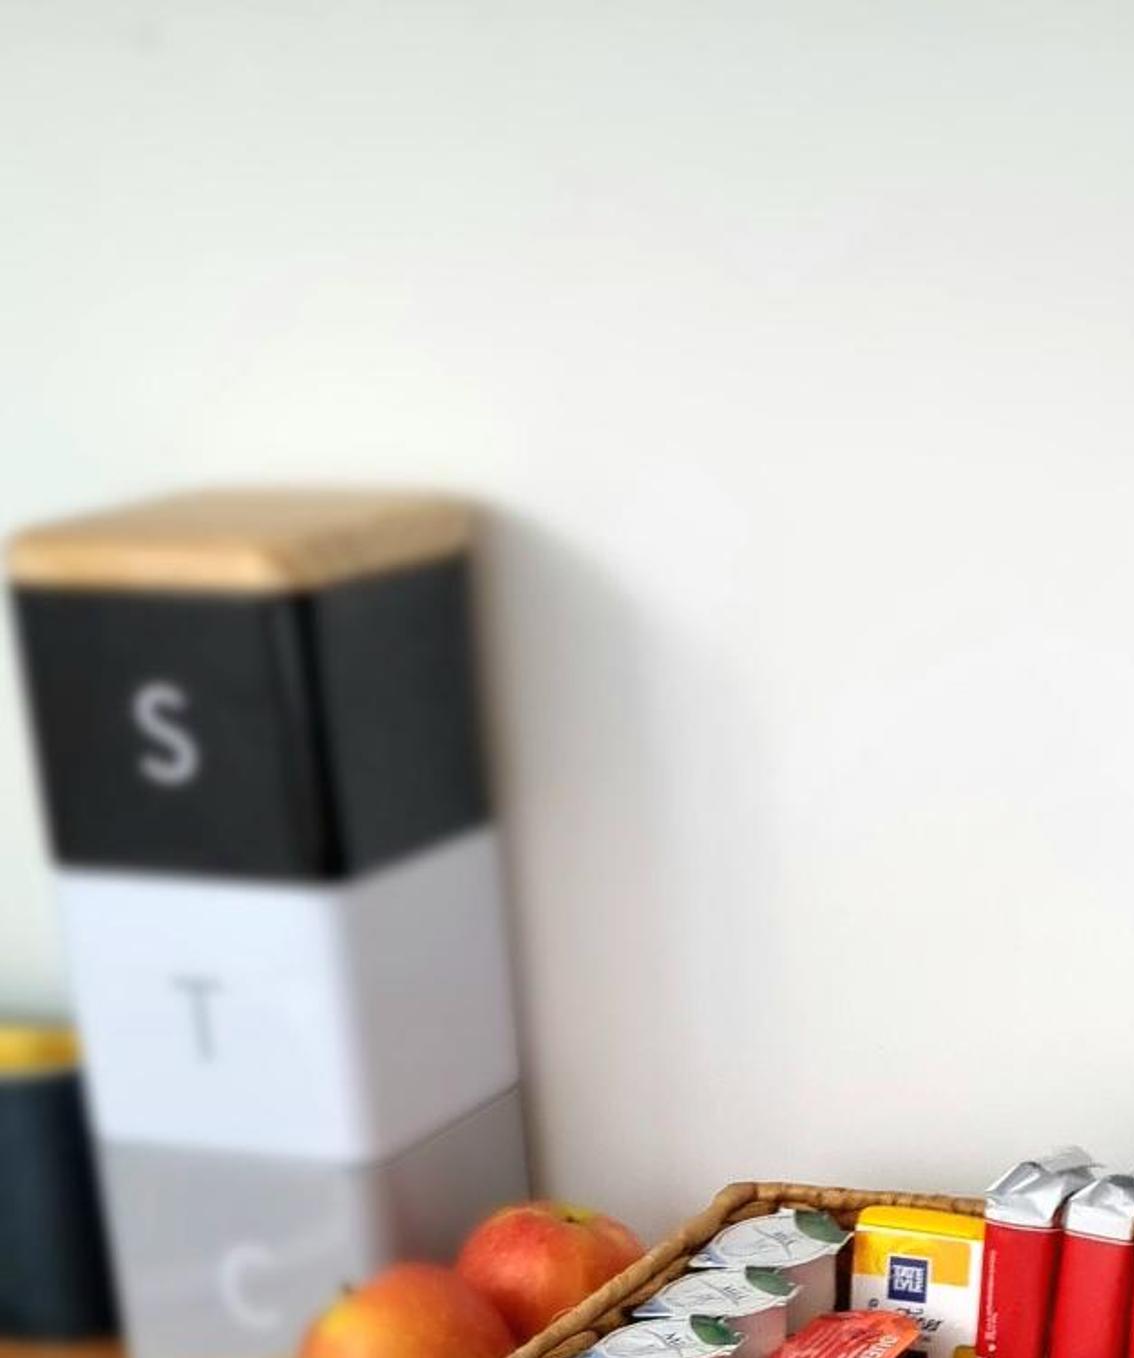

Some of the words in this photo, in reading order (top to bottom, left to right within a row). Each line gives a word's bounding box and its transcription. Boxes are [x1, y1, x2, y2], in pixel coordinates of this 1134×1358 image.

[132, 680, 199, 788] S
[172, 974, 222, 1062] T
[220, 1245, 280, 1328] C
